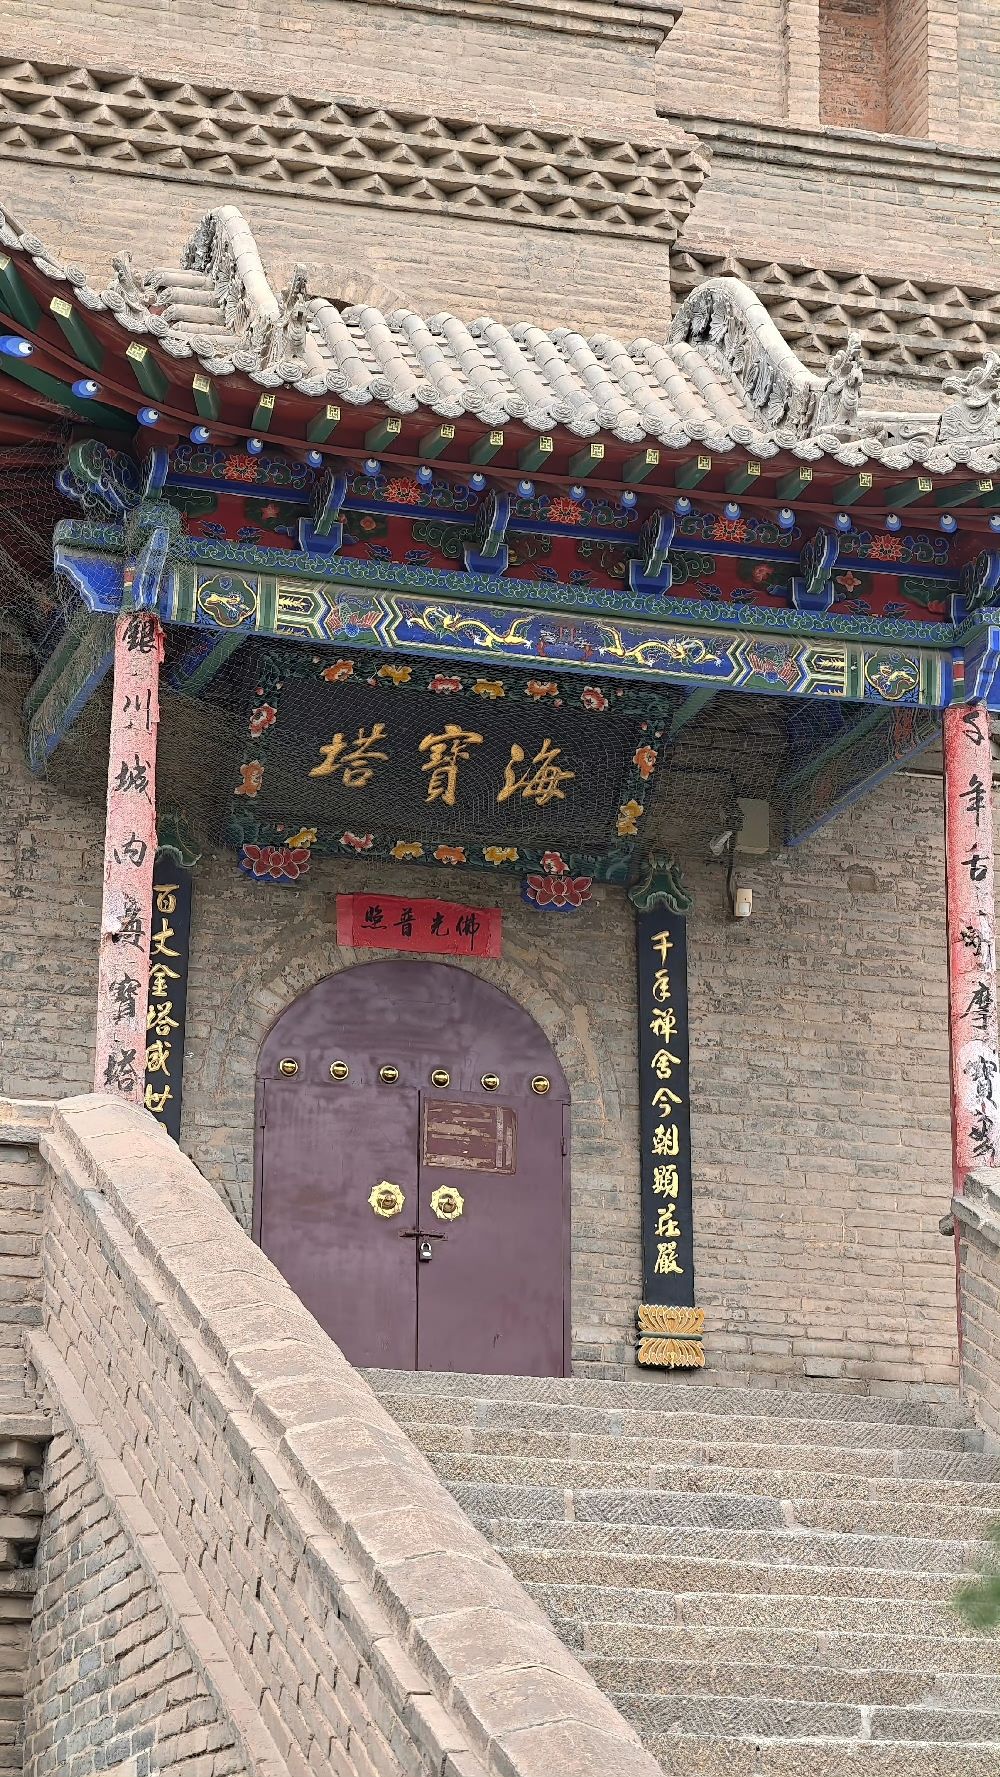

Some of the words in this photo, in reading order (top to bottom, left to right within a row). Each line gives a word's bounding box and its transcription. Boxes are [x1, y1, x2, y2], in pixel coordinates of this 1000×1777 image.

[308, 722, 576, 807] 海寶塔
[361, 904, 480, 951] 佛光普照
